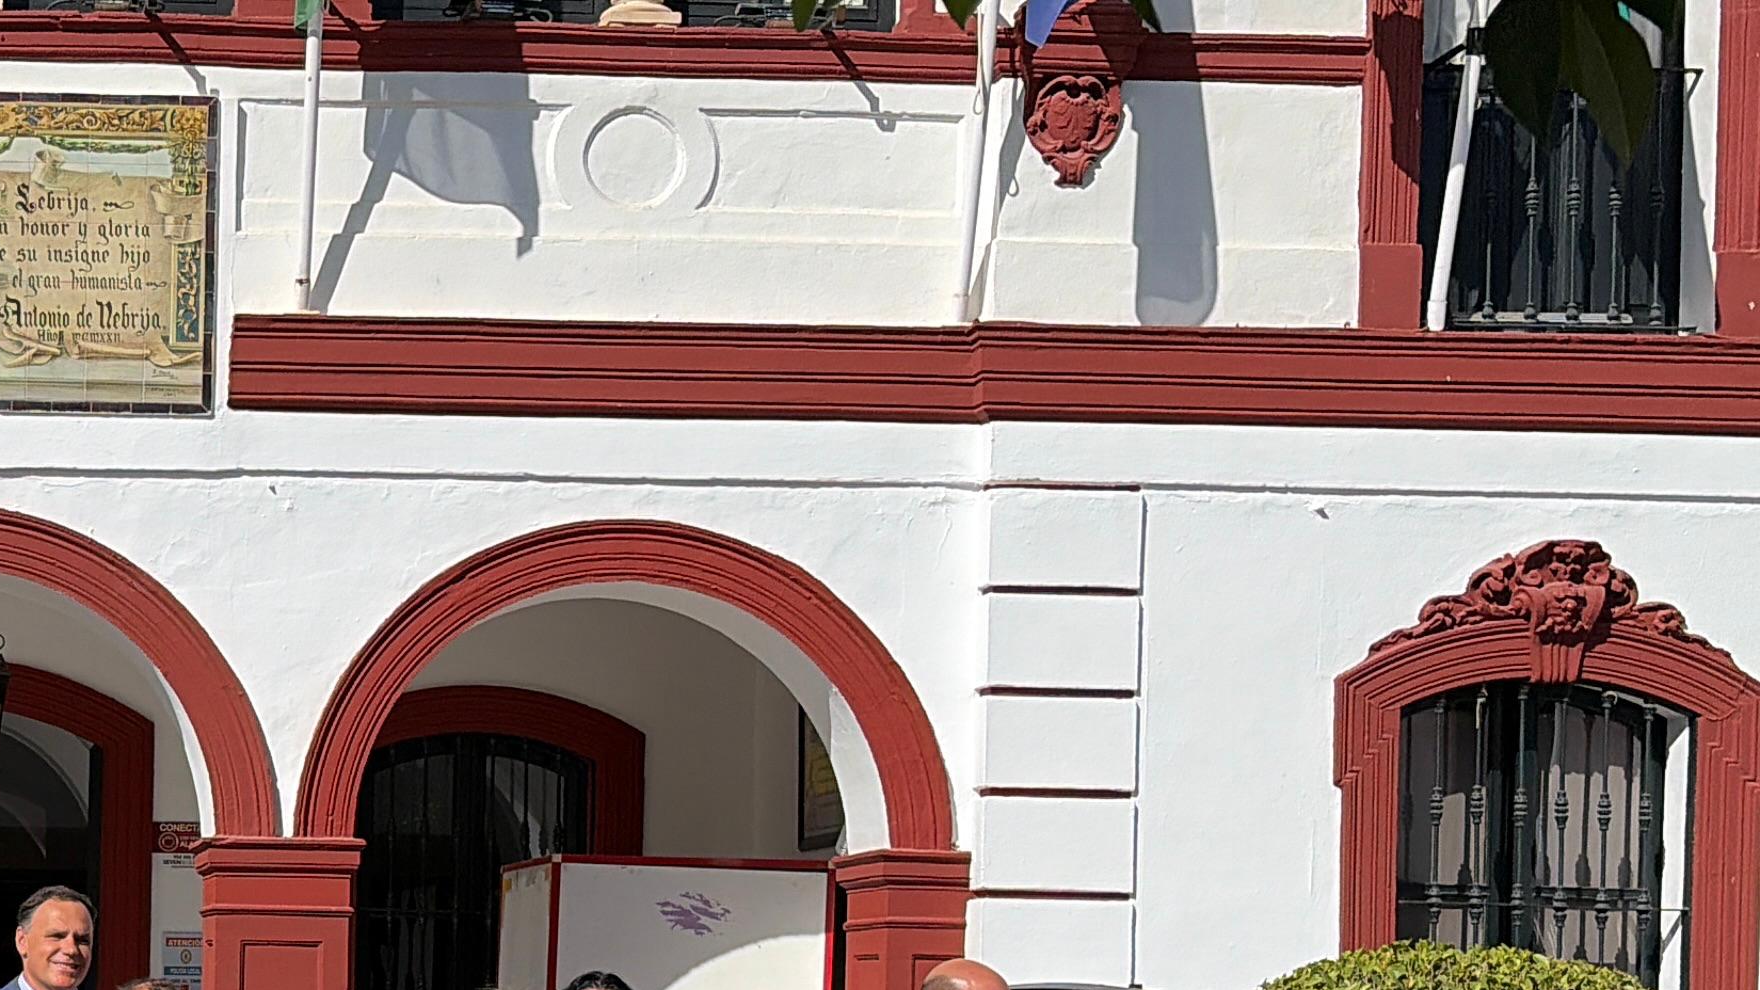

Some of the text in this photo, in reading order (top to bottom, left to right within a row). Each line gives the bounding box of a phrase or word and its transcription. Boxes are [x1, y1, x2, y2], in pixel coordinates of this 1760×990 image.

[20, 216, 69, 237] honor
[75, 221, 88, 244] y
[96, 218, 151, 246] gloria
[16, 247, 38, 262] su
[47, 242, 110, 272] insigne
[119, 242, 151, 272] hijo
[12, 268, 143, 298] el gran humanista
[76, 302, 93, 329] de
[159, 823, 200, 832] CONECT
